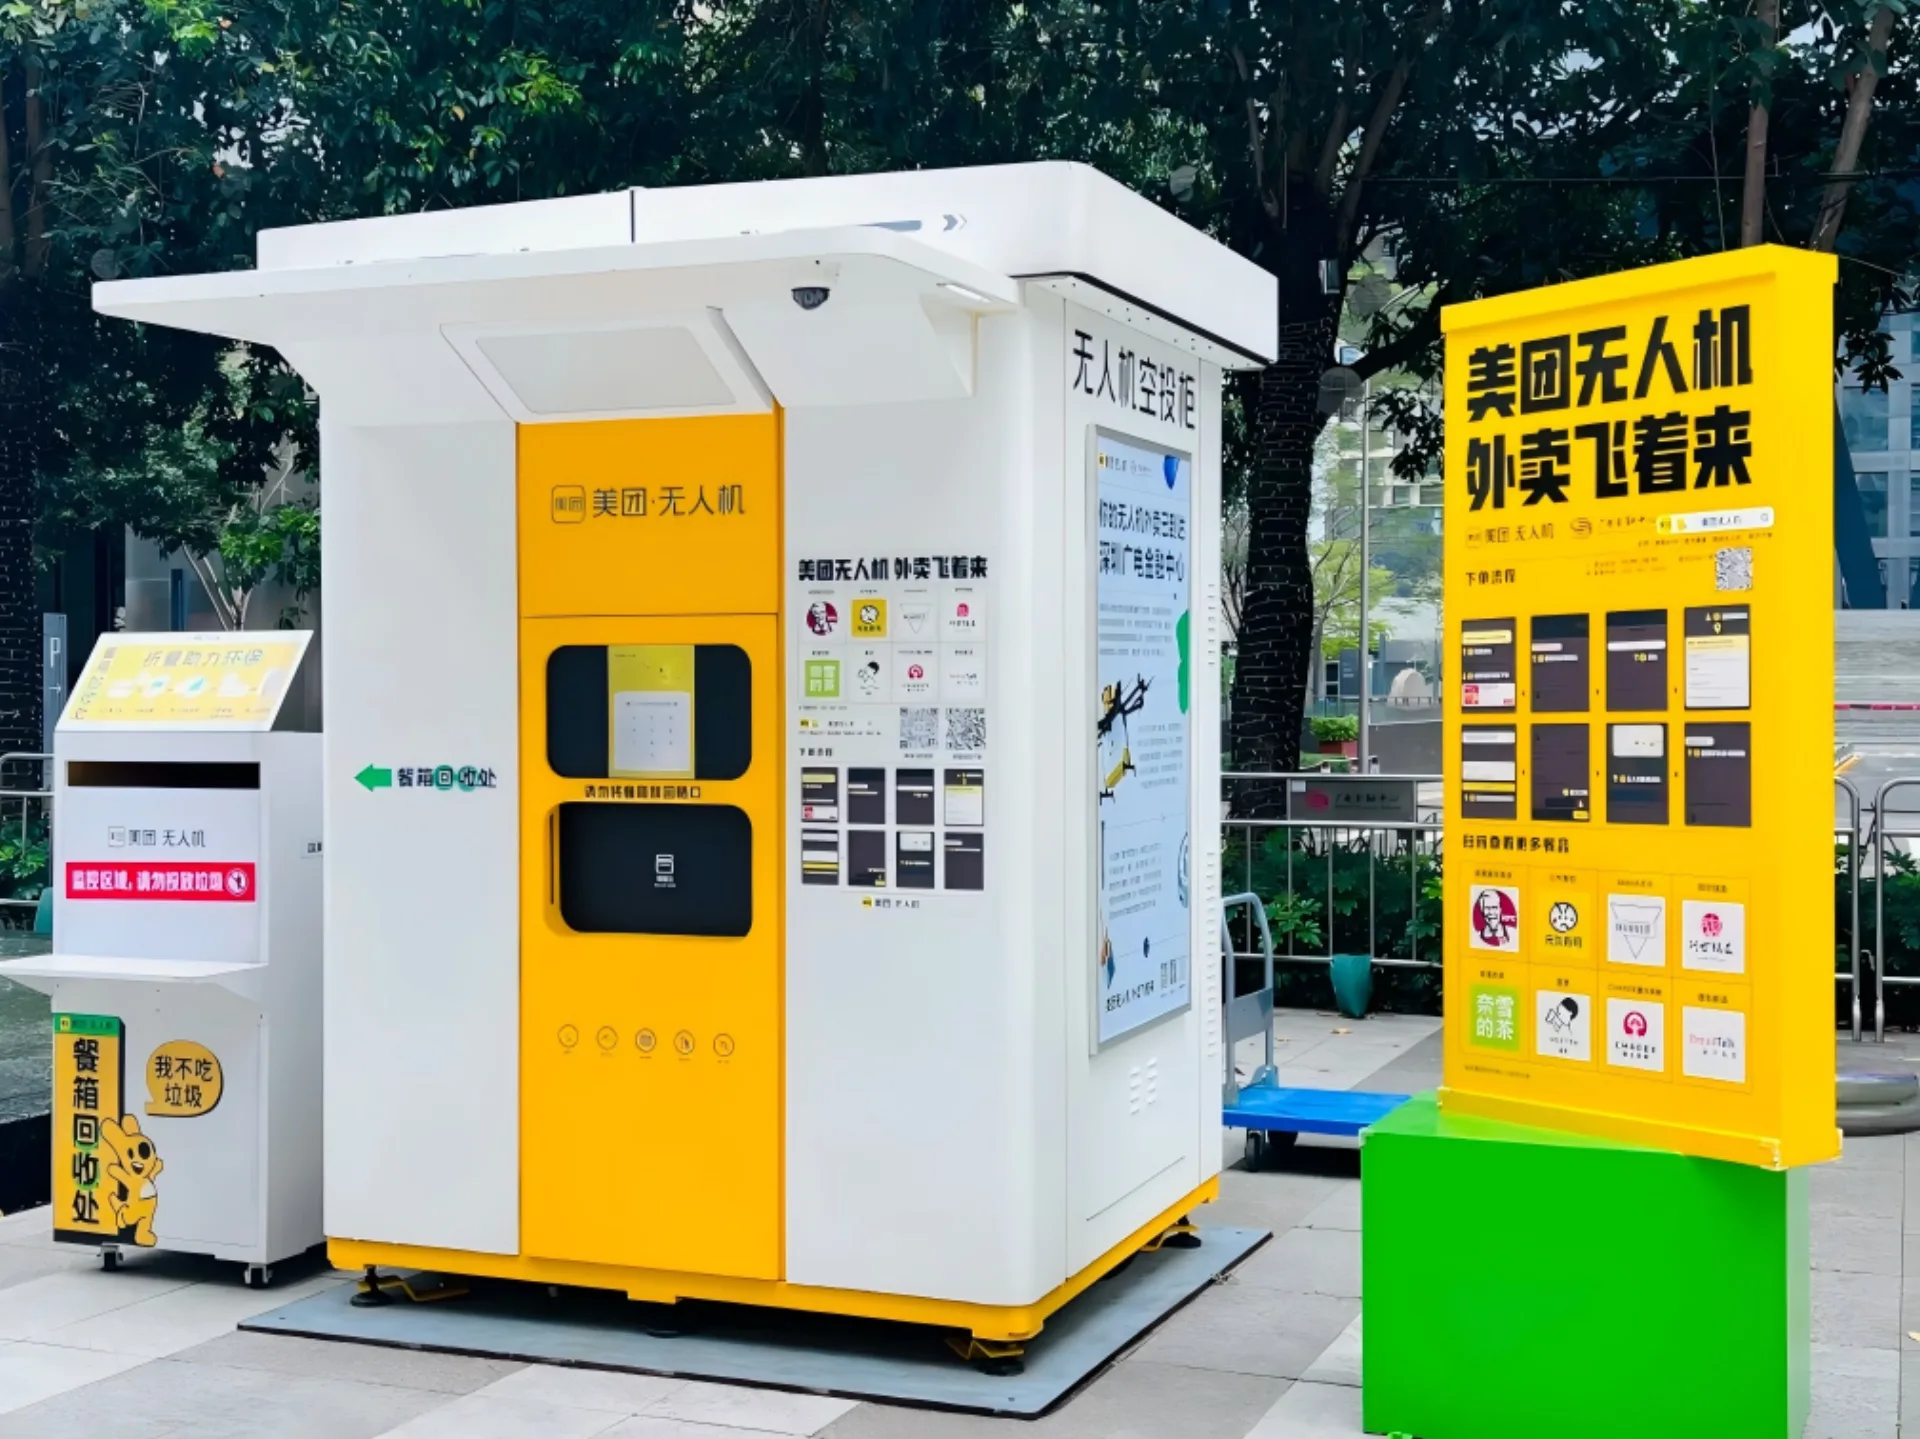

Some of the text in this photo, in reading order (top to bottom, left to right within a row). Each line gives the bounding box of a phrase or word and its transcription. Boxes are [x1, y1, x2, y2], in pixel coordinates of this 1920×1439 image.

[1467, 304, 1753, 423] 美团无人机
[1073, 329, 1196, 430] 无人机空投柜
[1467, 404, 1752, 513] 外卖飞着来
[1515, 522, 1554, 541] 无人机
[798, 555, 988, 582] 美团无人机 外卖飞着来
[50, 637, 60, 668] P
[162, 829, 206, 848] 无人机
[1476, 993, 1515, 1018] 奈雪
[1476, 1017, 1514, 1040] 的茶
[155, 1054, 214, 1083] 我不吃
[164, 1083, 203, 1109] 垃圾
[72, 1037, 100, 1225] 餐箱回收处
